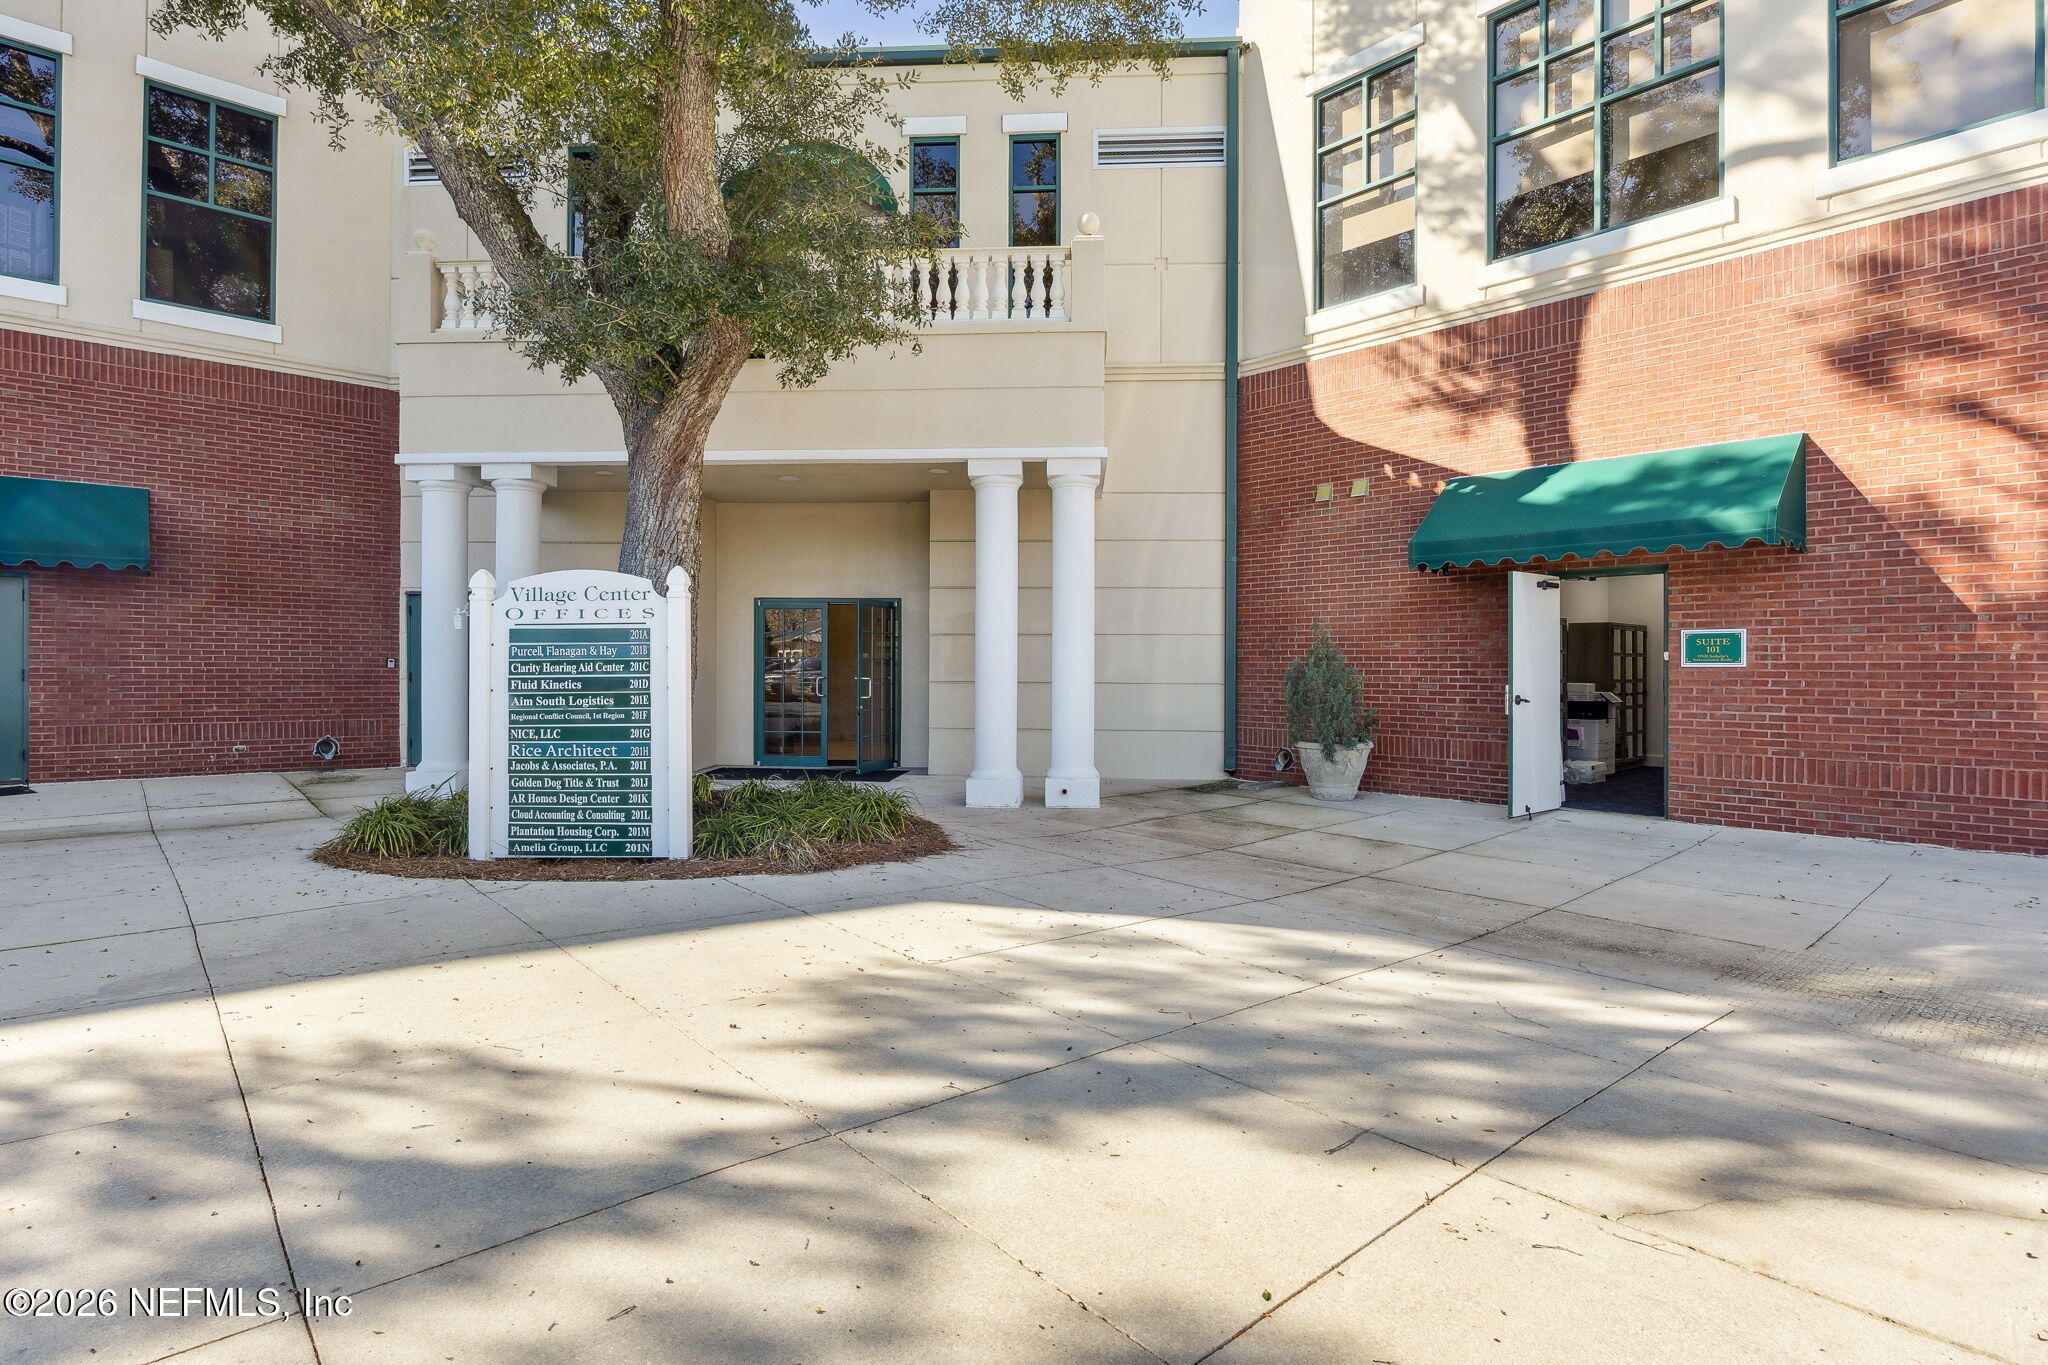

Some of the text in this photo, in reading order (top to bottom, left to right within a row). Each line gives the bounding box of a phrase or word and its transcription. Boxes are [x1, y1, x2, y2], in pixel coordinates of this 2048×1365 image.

[510, 586, 651, 605] Village Center
[505, 608, 655, 620] OFFICES
[630, 630, 648, 639] 201A
[511, 646, 648, 658] Purcell, Flanagan & Hay 201B
[511, 662, 648, 674] Clarity Hearing Aid Center 201C
[511, 679, 648, 690] Fluid Kinetics 201D
[511, 695, 648, 707] Aim South Logistics 201E
[631, 711, 648, 720] 201F
[510, 728, 650, 740] NICE, LLC 201G
[511, 744, 649, 756] Rice Architect 201H
[510, 761, 539, 770] Jacobs
[542, 761, 550, 770] &
[552, 761, 597, 771] Associates,
[600, 761, 617, 770] P.A.
[511, 778, 648, 789] Golden Dog Title & Trust 201J
[511, 794, 648, 805] AR Homes Design Center 201K
[512, 810, 650, 821] Cloud Accounting & Consulting 201L
[510, 826, 650, 838] Plantation Housing Corp. 201M
[513, 843, 650, 853] Amelia Group, LLC 201N
